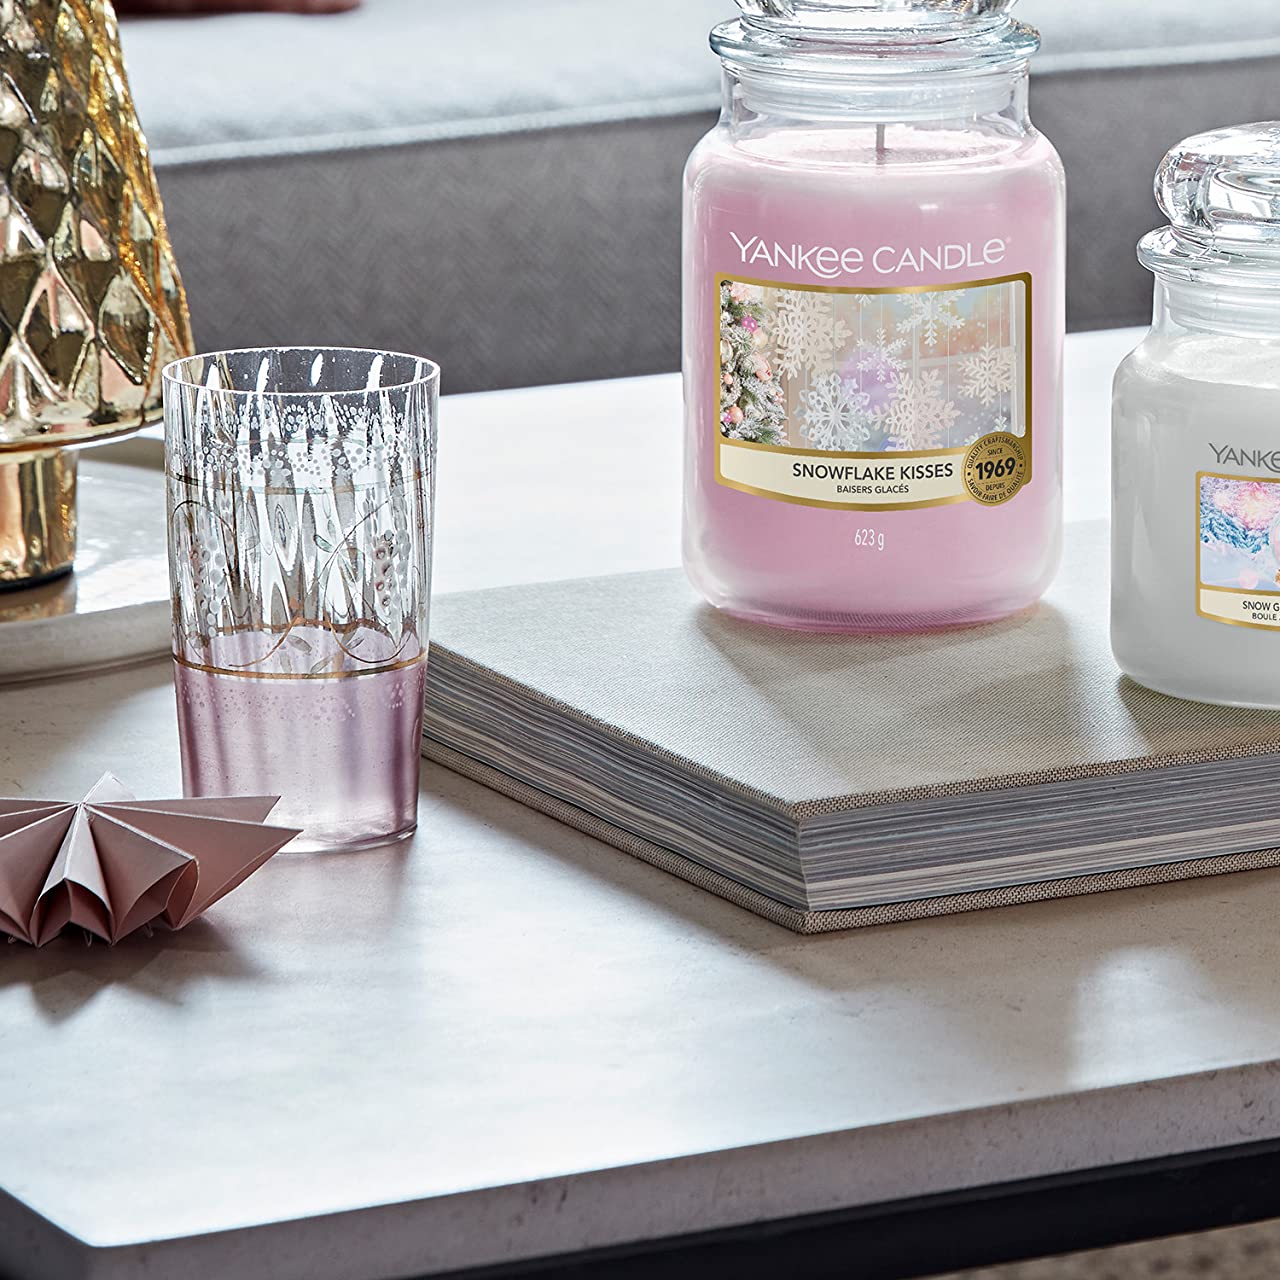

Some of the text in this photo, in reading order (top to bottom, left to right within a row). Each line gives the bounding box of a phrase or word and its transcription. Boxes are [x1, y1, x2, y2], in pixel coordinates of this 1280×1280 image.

[792, 462, 954, 482] SNOWFLAKE KISSES
[975, 457, 1016, 480] 1969
[836, 482, 910, 495] BAISERS GLACÉS
[854, 528, 885, 551] 623 g
[1242, 600, 1271, 611] SNOW
[1252, 612, 1278, 621] BOULE
